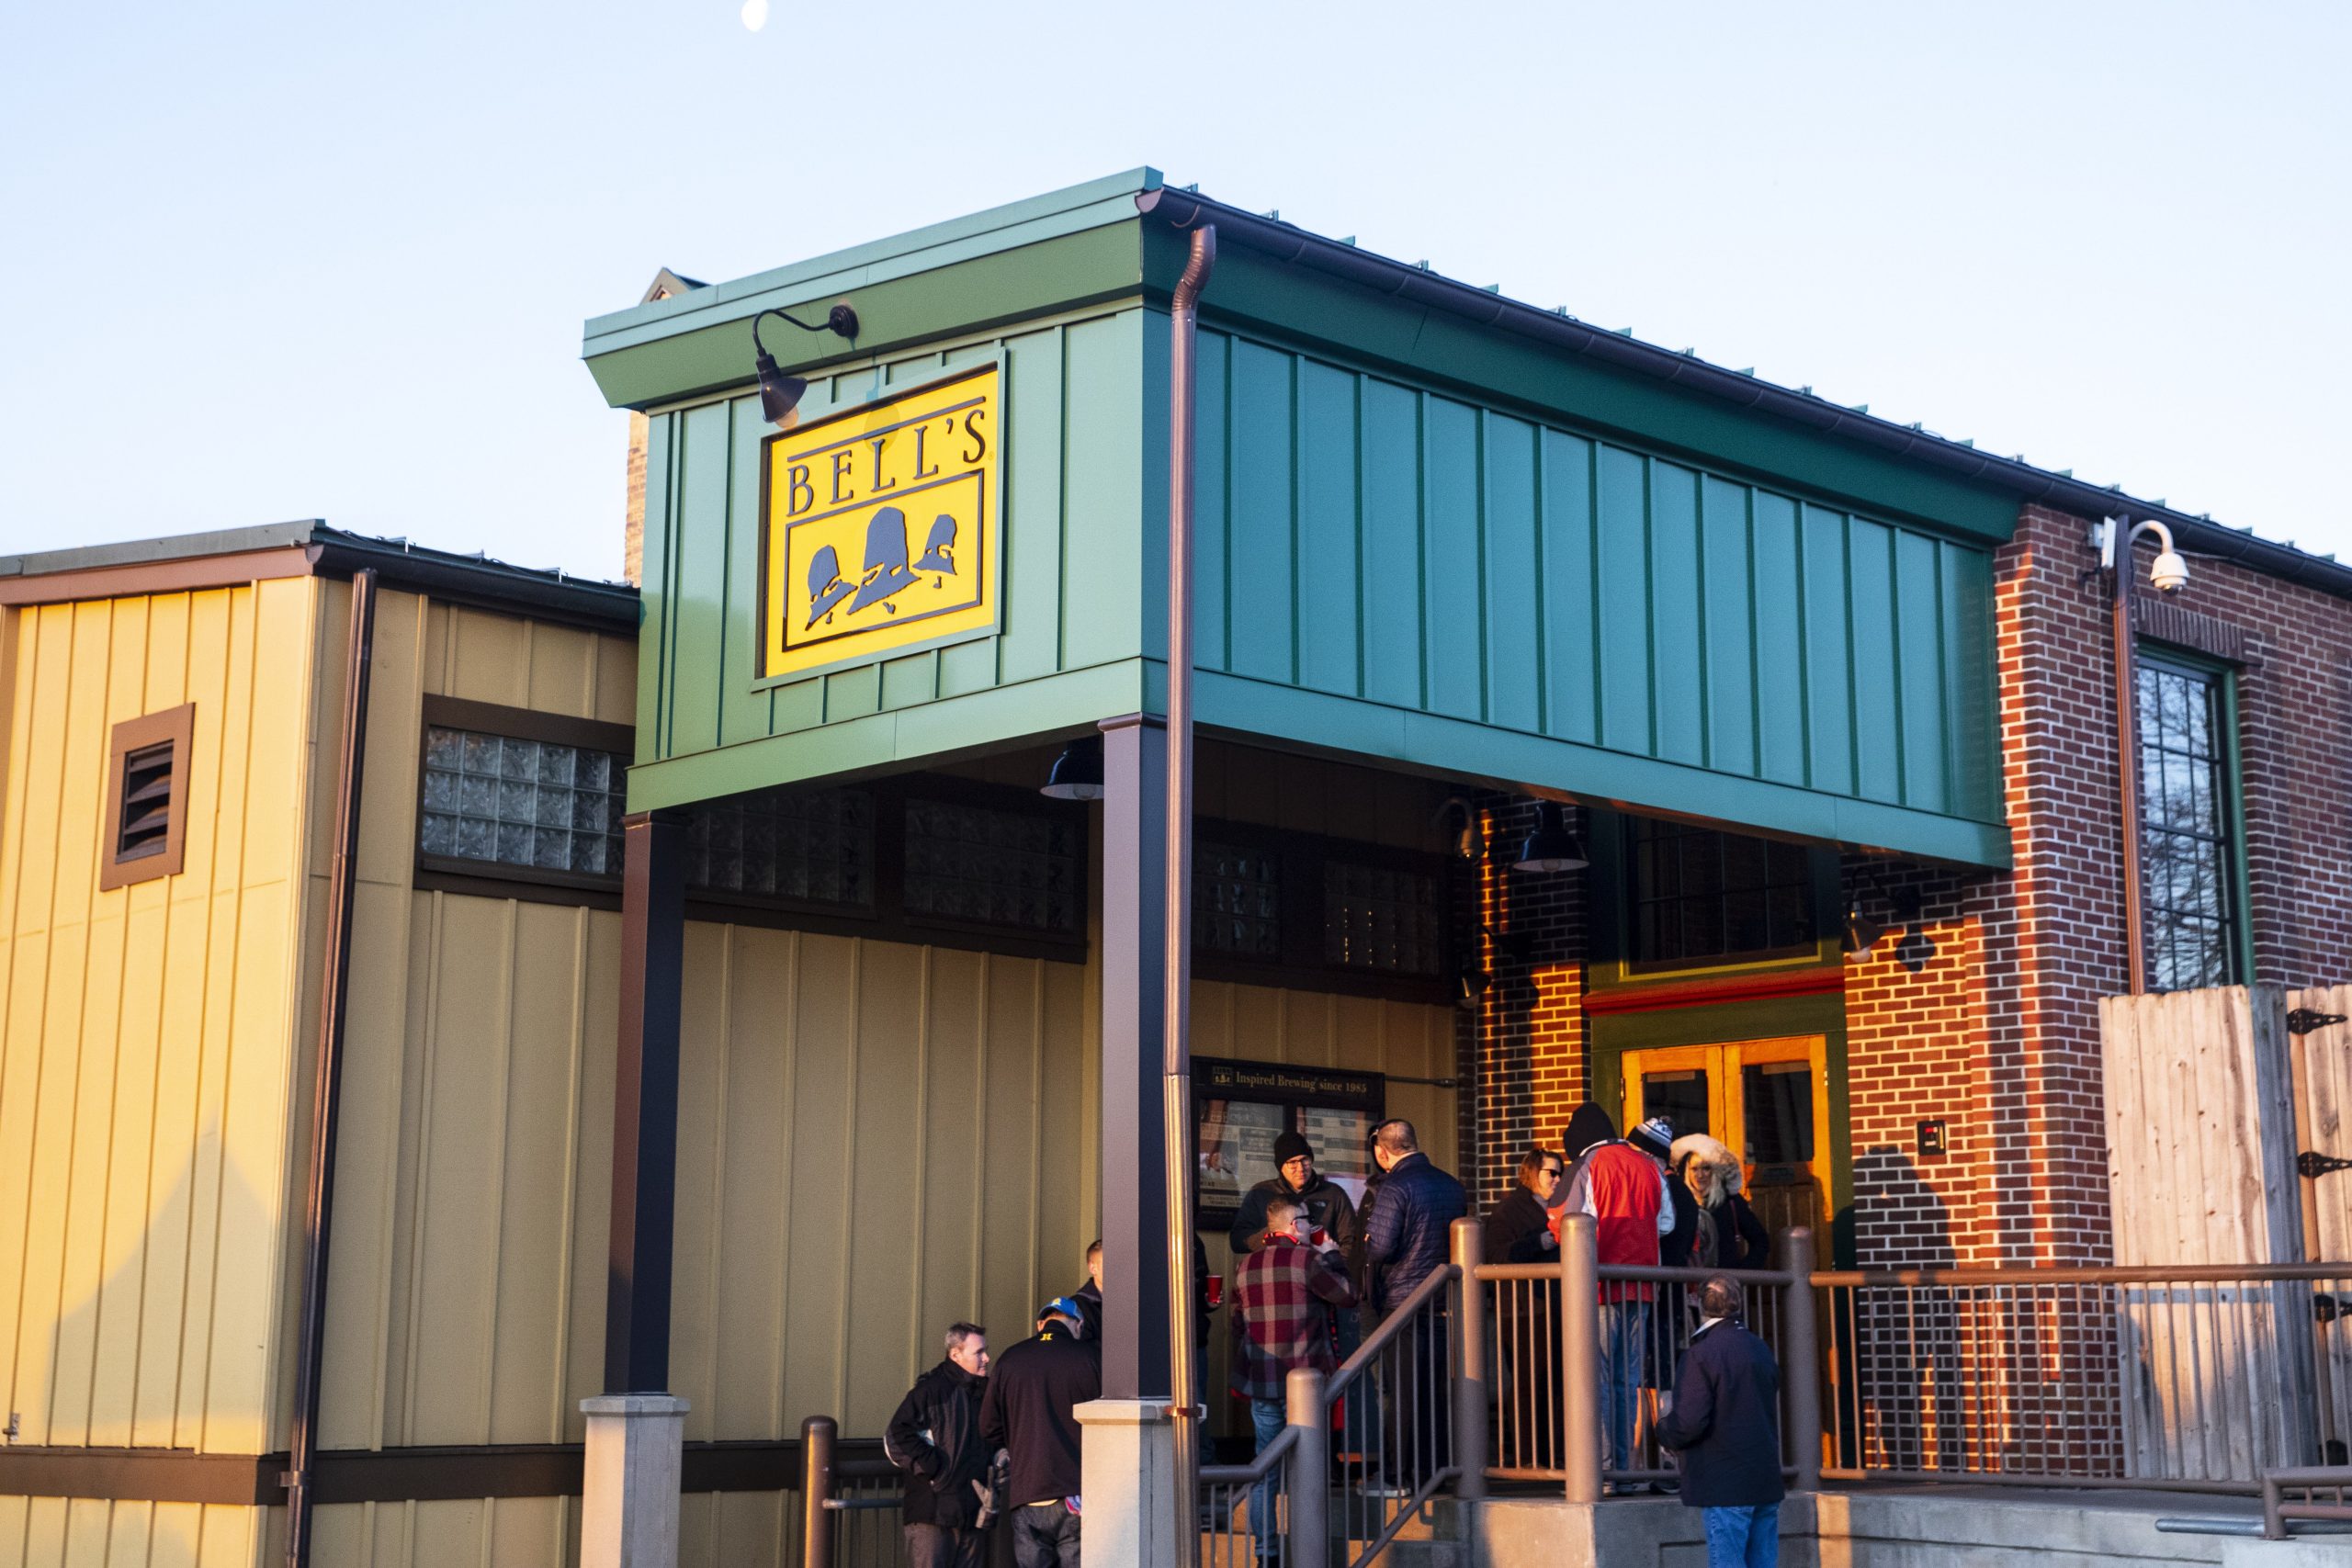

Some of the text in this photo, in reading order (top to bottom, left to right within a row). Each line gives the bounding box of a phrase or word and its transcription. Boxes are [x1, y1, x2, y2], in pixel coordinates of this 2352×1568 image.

[786, 409, 987, 517] BELL'S
[1236, 1071, 1367, 1094] Inspired Brewing since 1985
